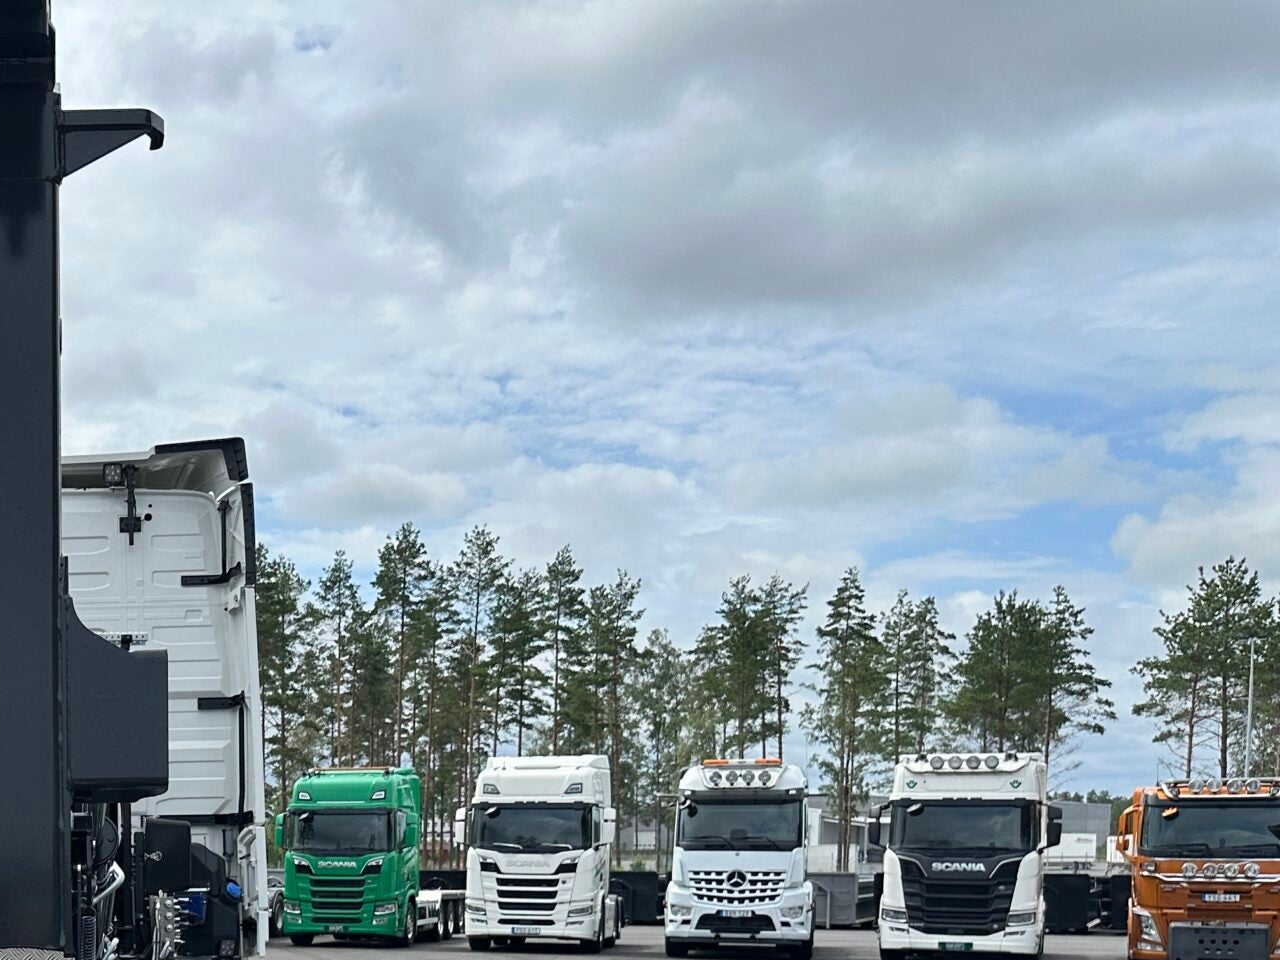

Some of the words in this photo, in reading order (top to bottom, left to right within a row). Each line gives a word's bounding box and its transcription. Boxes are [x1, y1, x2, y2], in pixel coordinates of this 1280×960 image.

[317, 860, 357, 868] SCANIA
[505, 859, 550, 868] SCANIA
[931, 862, 986, 872] SCANIA
